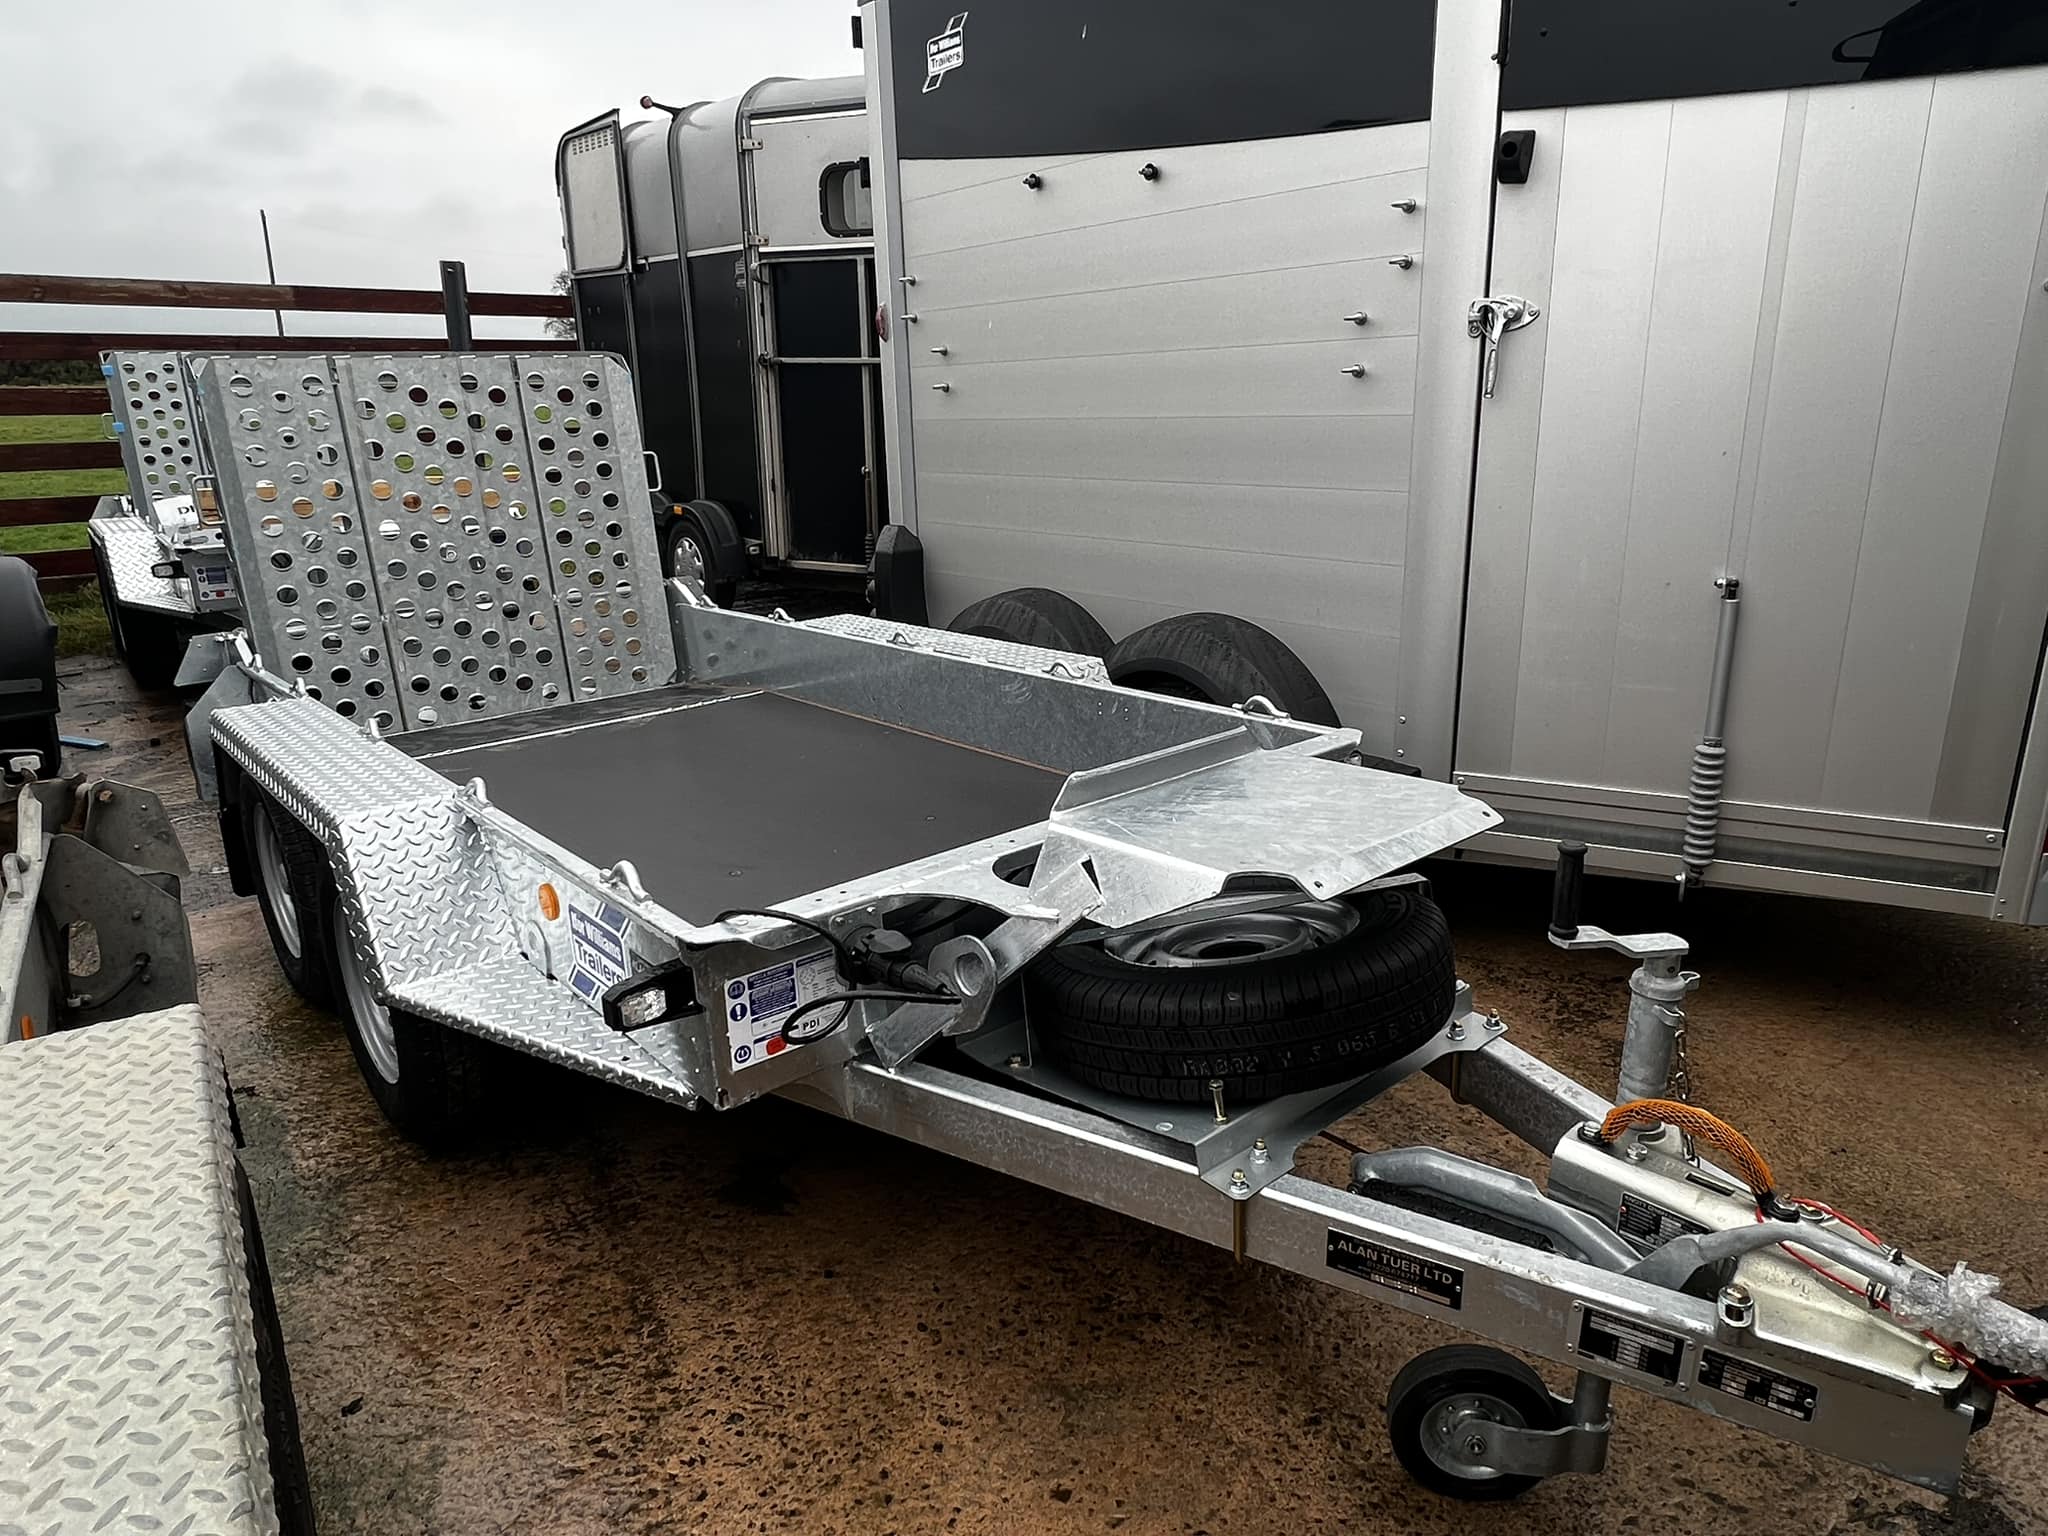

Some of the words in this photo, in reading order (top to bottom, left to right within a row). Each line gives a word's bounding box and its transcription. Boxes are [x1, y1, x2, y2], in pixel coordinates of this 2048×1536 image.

[930, 51, 961, 69] Trailers
[802, 1017, 821, 1031] PDI
[1337, 1239, 1378, 1261] ALAN
[1381, 1252, 1421, 1275] TUER
[1423, 1266, 1454, 1285] LTD
